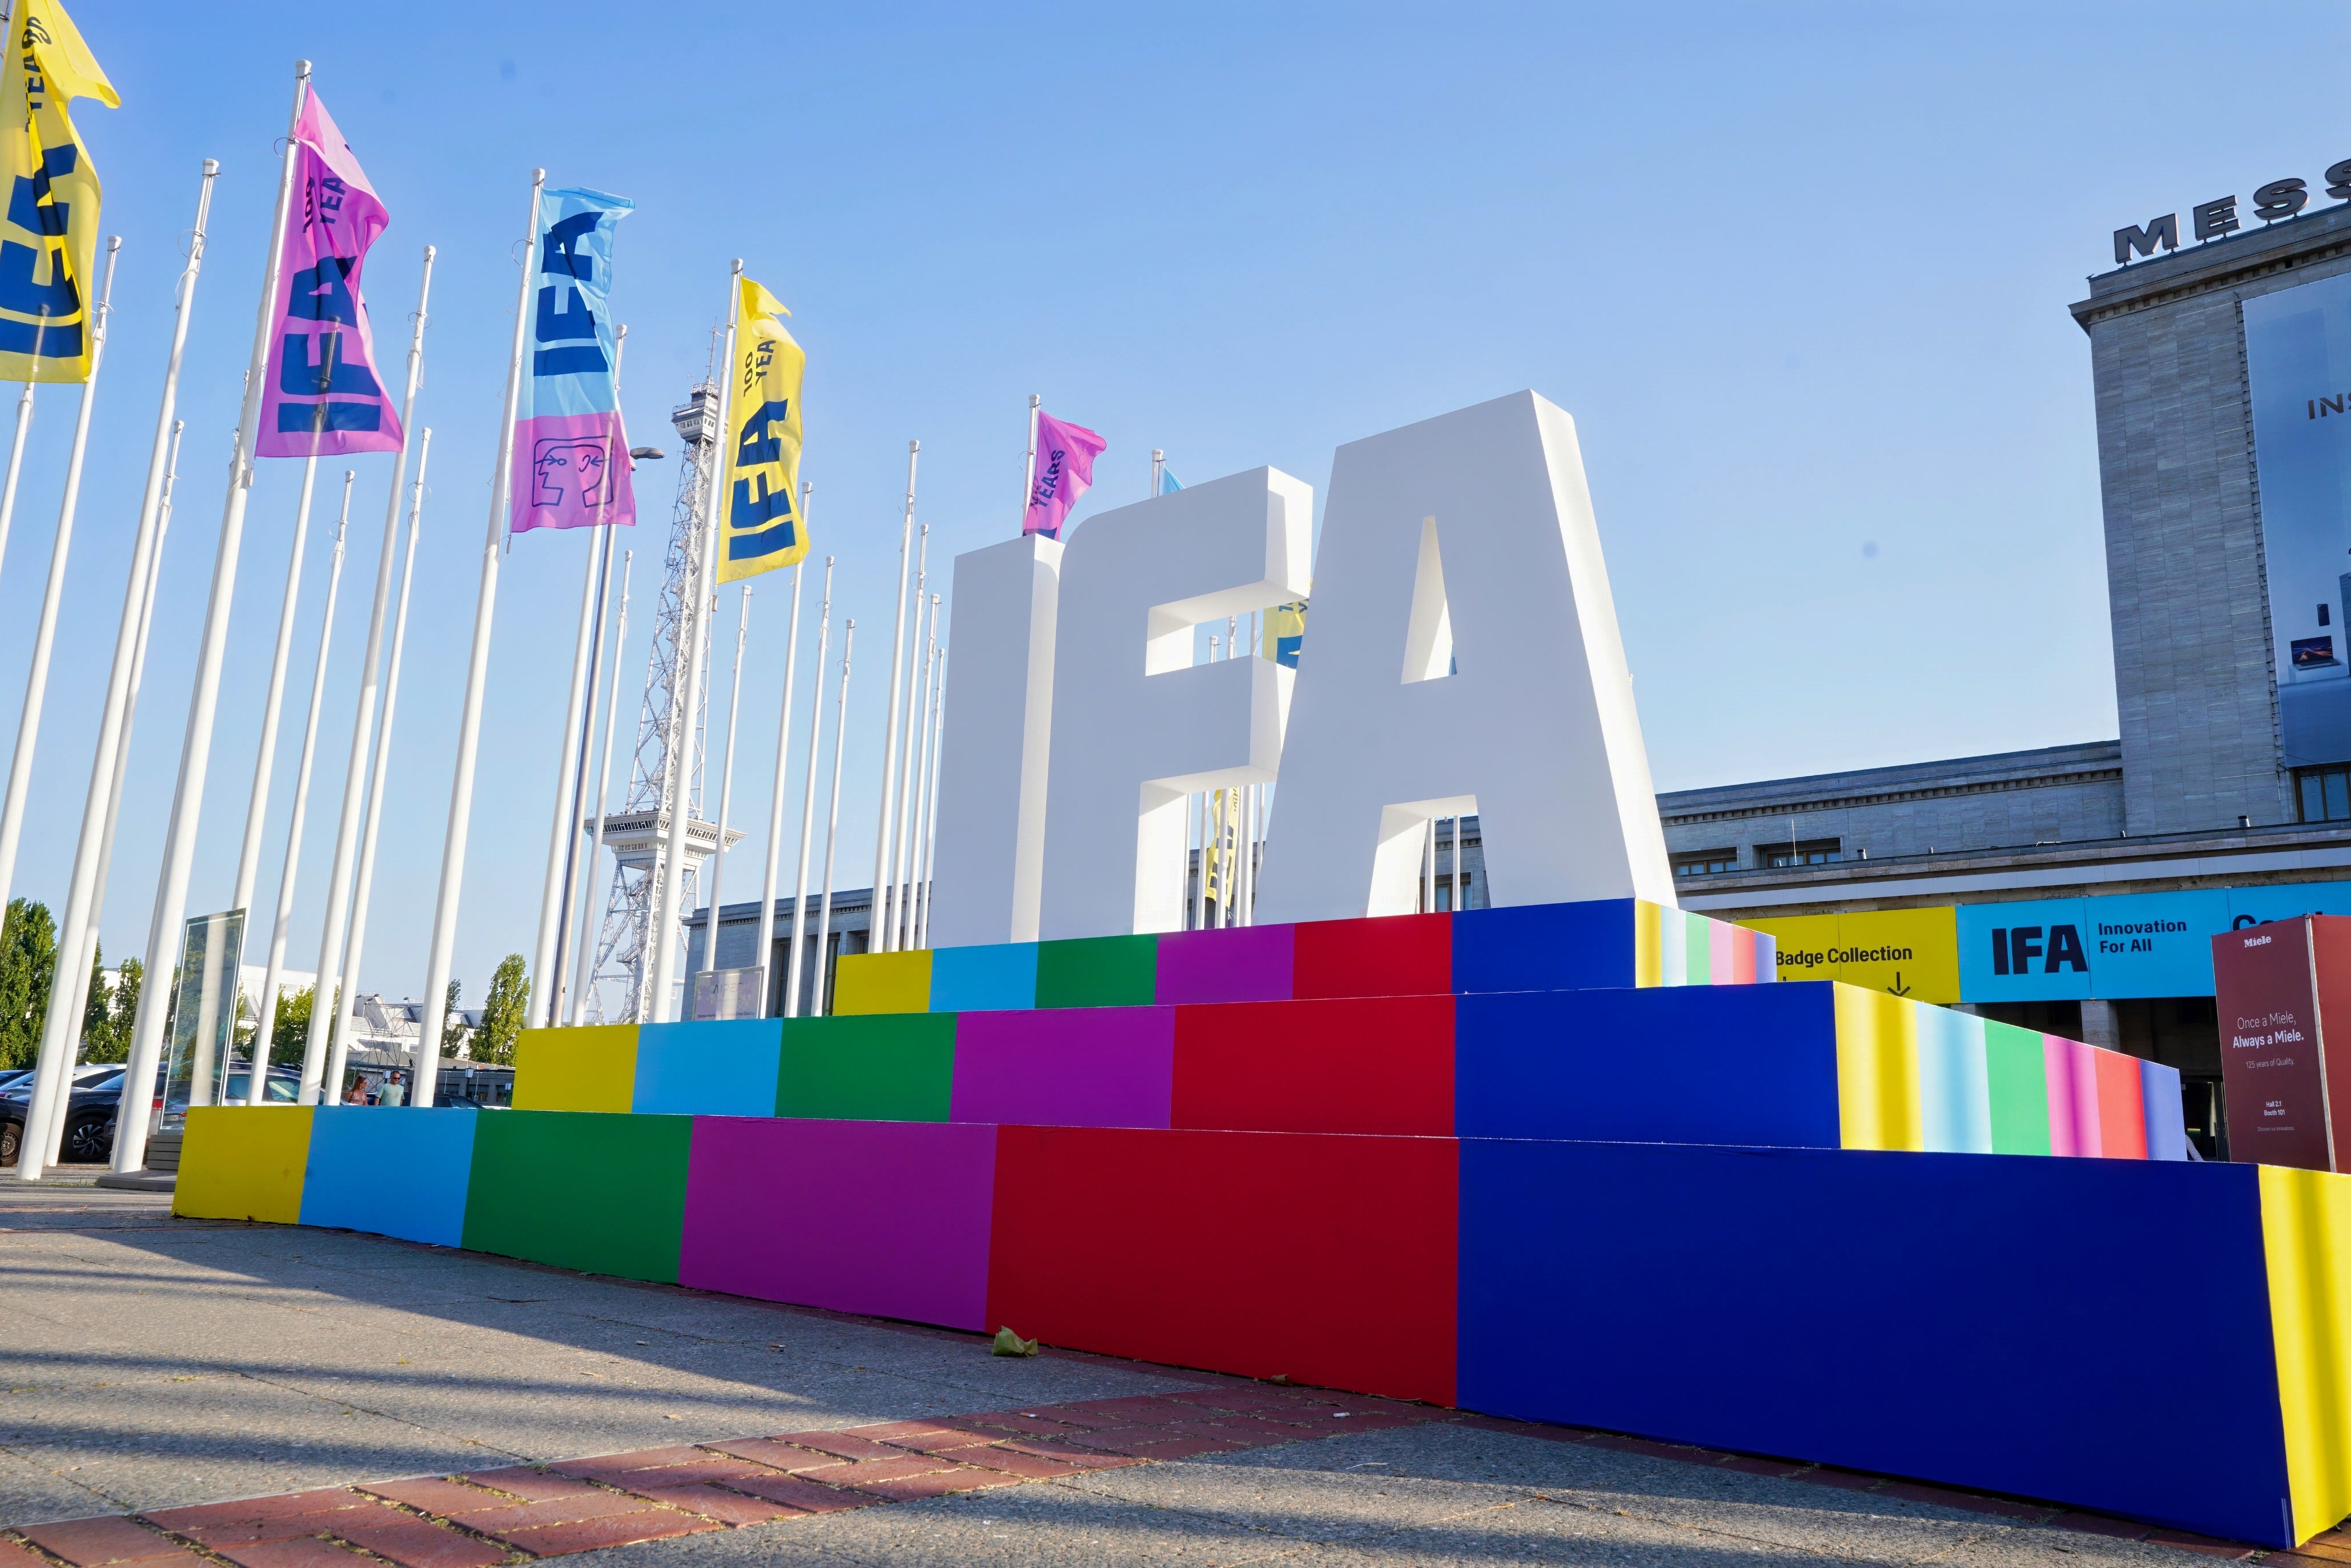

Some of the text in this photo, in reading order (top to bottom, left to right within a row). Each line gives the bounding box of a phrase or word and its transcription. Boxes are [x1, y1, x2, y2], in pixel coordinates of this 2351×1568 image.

[319, 167, 346, 224] YEA
[0, 144, 83, 358] IFA
[533, 211, 608, 377] IFA
[278, 256, 381, 433] IFA
[755, 337, 776, 387] YEA
[743, 351, 753, 398] 100
[2308, 392, 2351, 420] IN
[729, 398, 796, 561] IFA
[1038, 450, 1066, 507] YEARS
[930, 389, 1679, 945] IFA
[1992, 924, 2089, 975] IFA
[2098, 919, 2187, 936] Innovation
[2099, 938, 2152, 953] For All
[2244, 935, 2272, 947] Miele
[1776, 945, 1913, 968] Badge Collection
[2233, 1028, 2304, 1049] Always a Miele.
[2237, 1010, 2296, 1030] Once a Miele,
[2245, 1057, 2295, 1069] 125 years of Quality.
